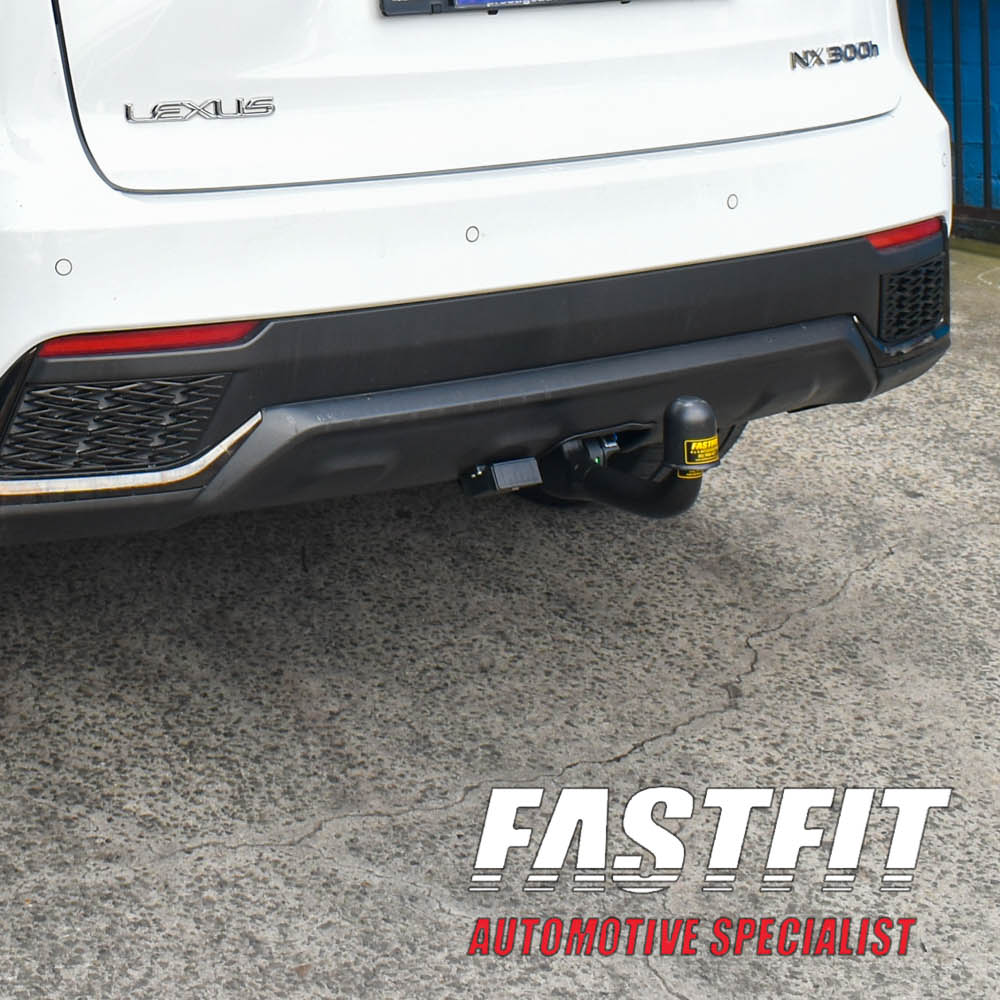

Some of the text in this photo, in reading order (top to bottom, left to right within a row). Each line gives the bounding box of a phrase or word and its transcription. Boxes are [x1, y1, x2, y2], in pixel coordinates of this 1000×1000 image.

[790, 41, 879, 70] NX 300h
[125, 97, 275, 124] LEXUS
